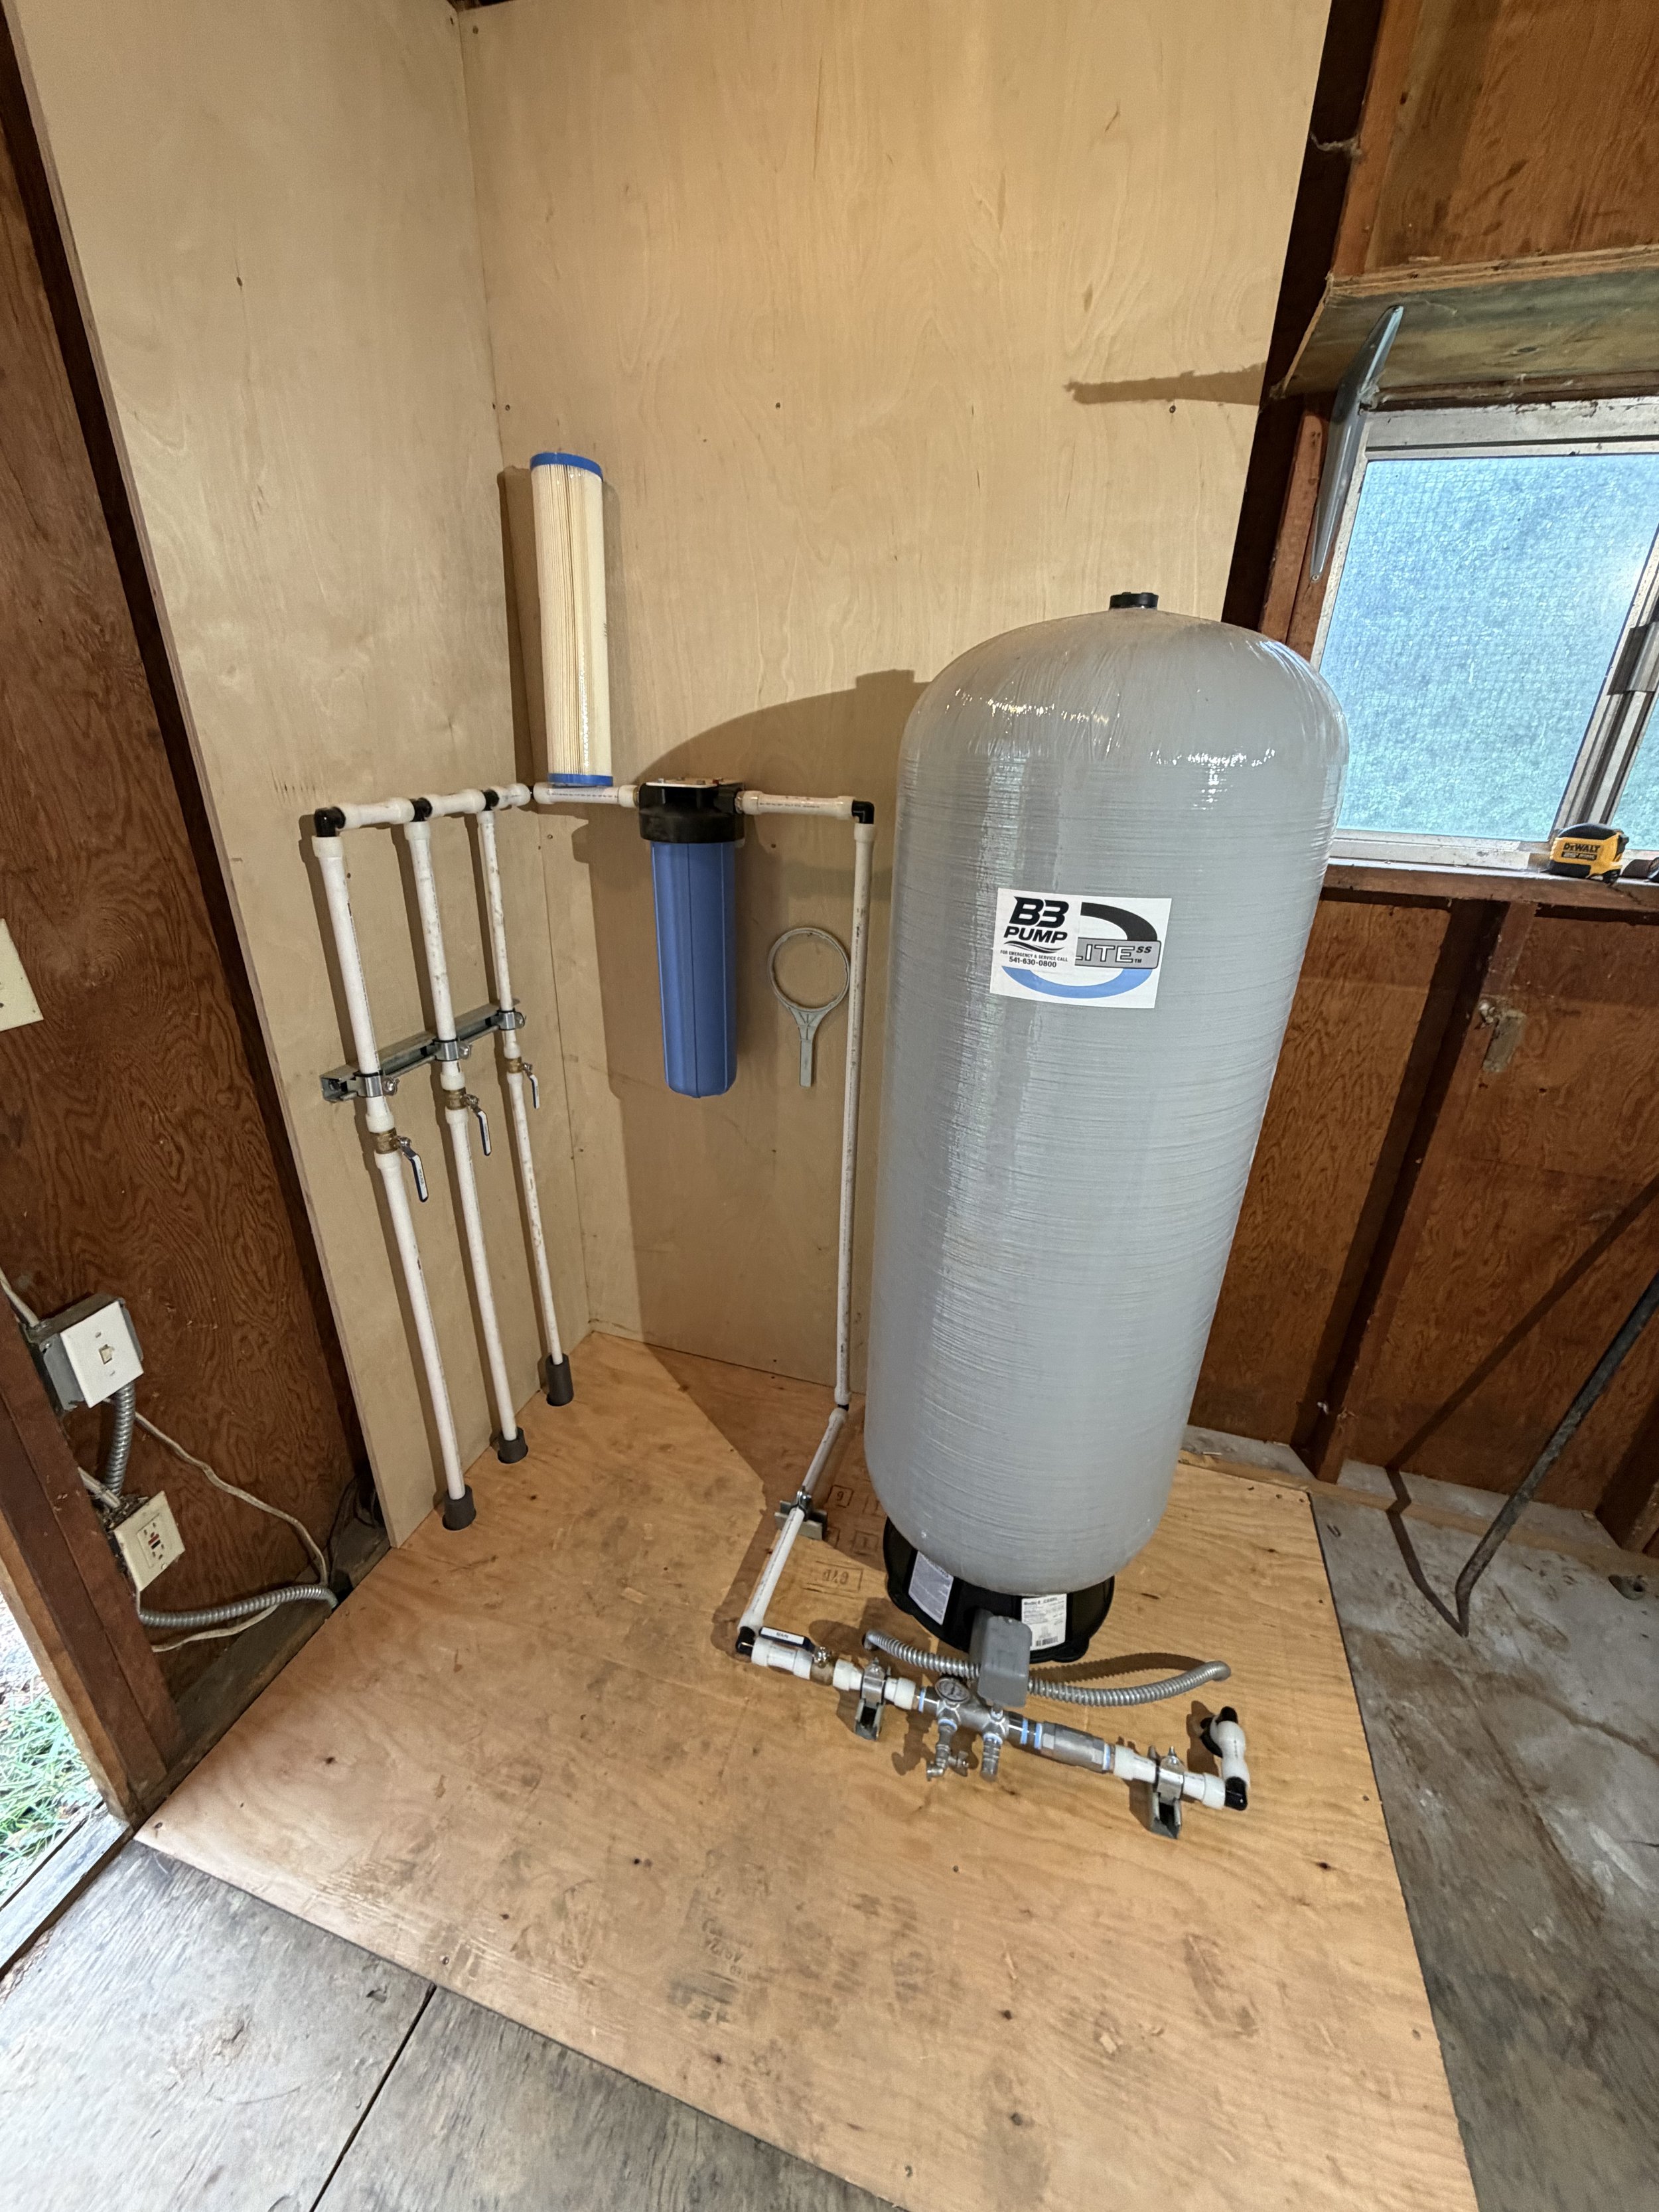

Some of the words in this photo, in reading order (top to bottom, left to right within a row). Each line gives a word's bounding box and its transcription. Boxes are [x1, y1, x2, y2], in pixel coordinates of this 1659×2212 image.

[1009, 896, 1069, 928] B3
[1003, 926, 1068, 944] PUMP
[1009, 956, 1057, 968] 541-630-0800
